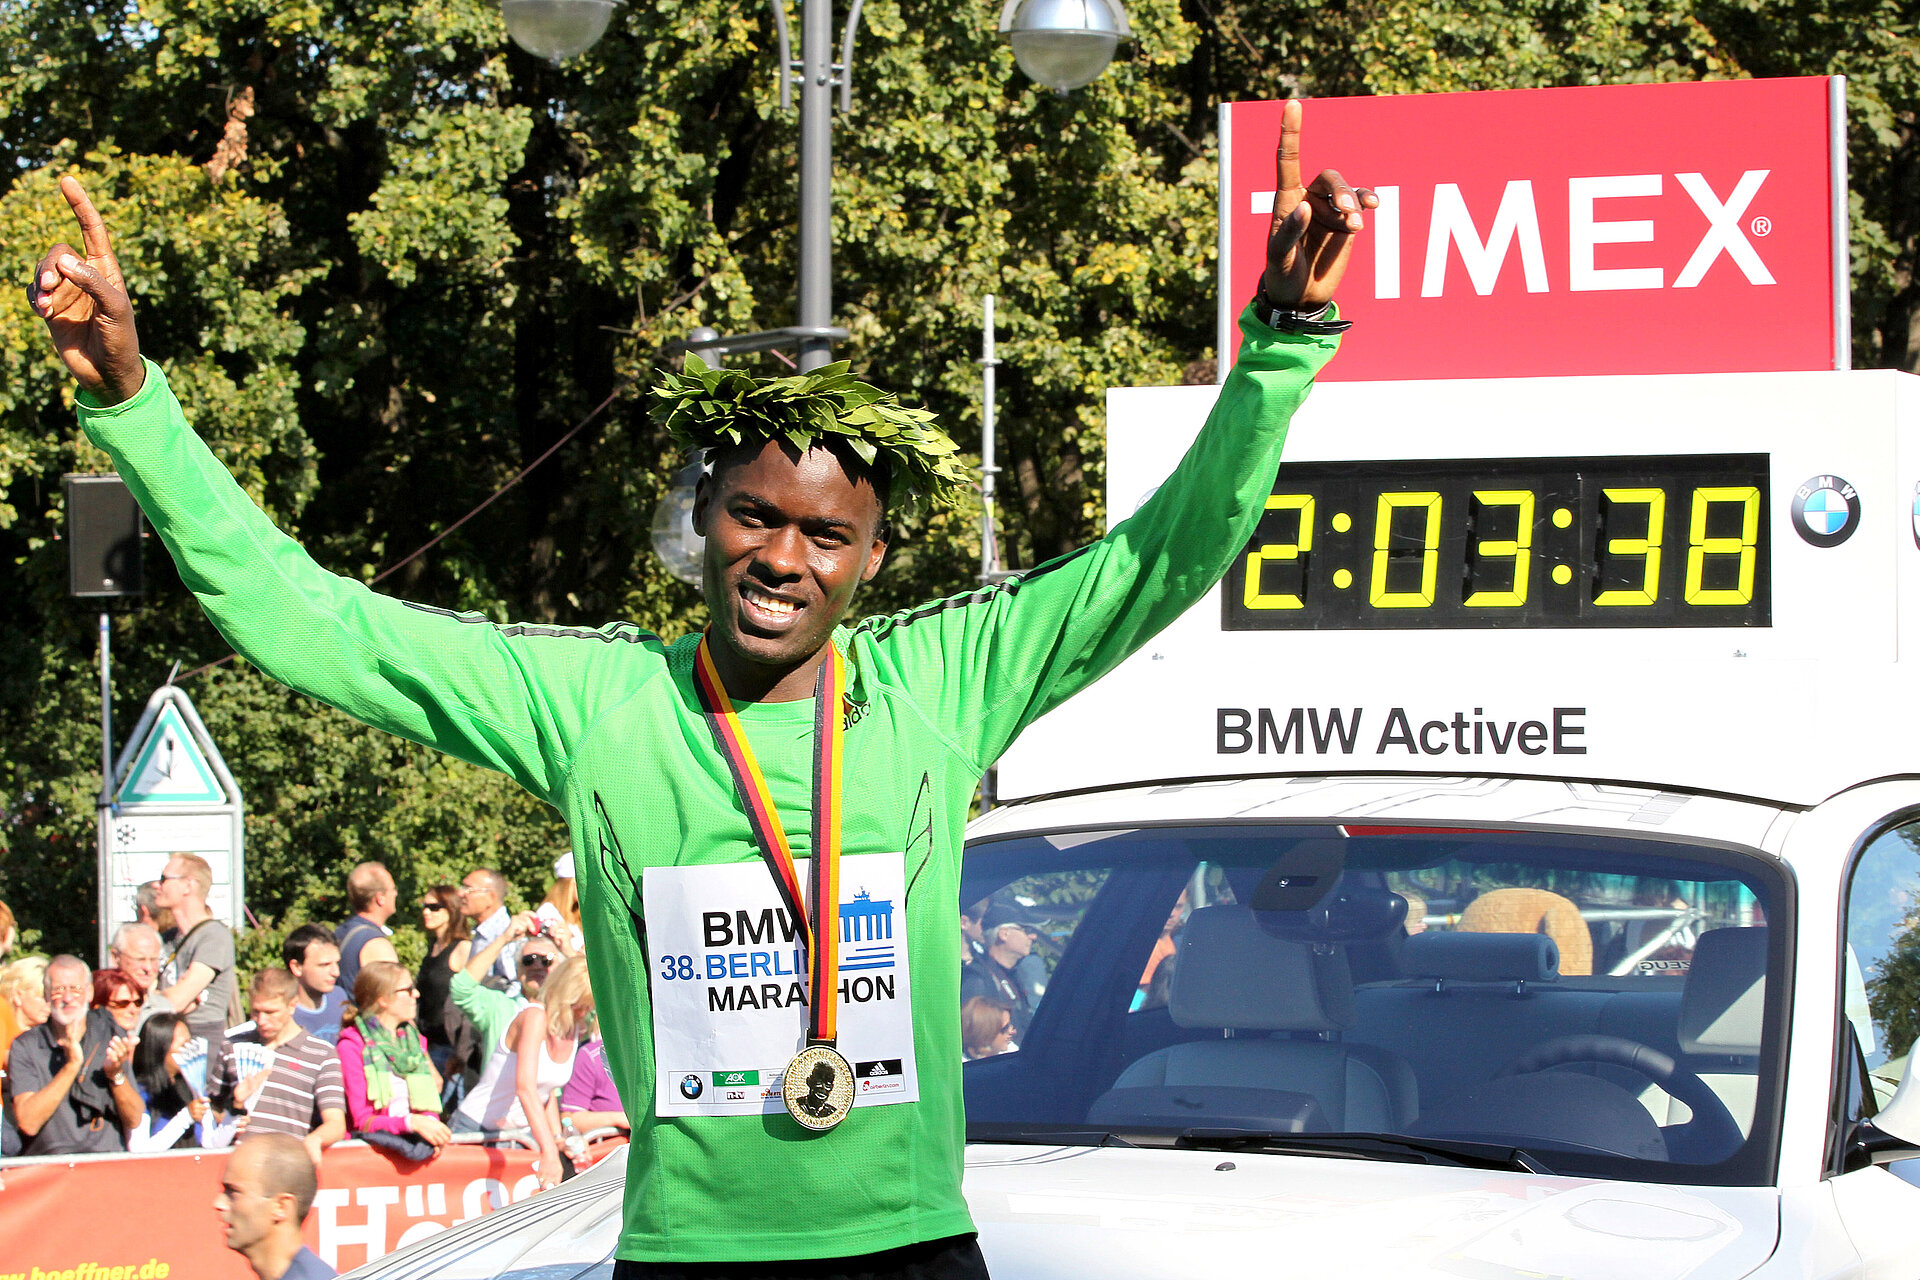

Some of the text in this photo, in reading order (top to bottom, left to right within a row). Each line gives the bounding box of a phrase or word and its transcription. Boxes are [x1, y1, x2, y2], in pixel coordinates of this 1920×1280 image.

[1244, 486, 1760, 609] 2:03:38
[1217, 707, 1587, 755] BMW ActiveE
[660, 955, 701, 980] 38.
[708, 974, 895, 1012] MARAHON
[725, 1073, 746, 1082] AOK
